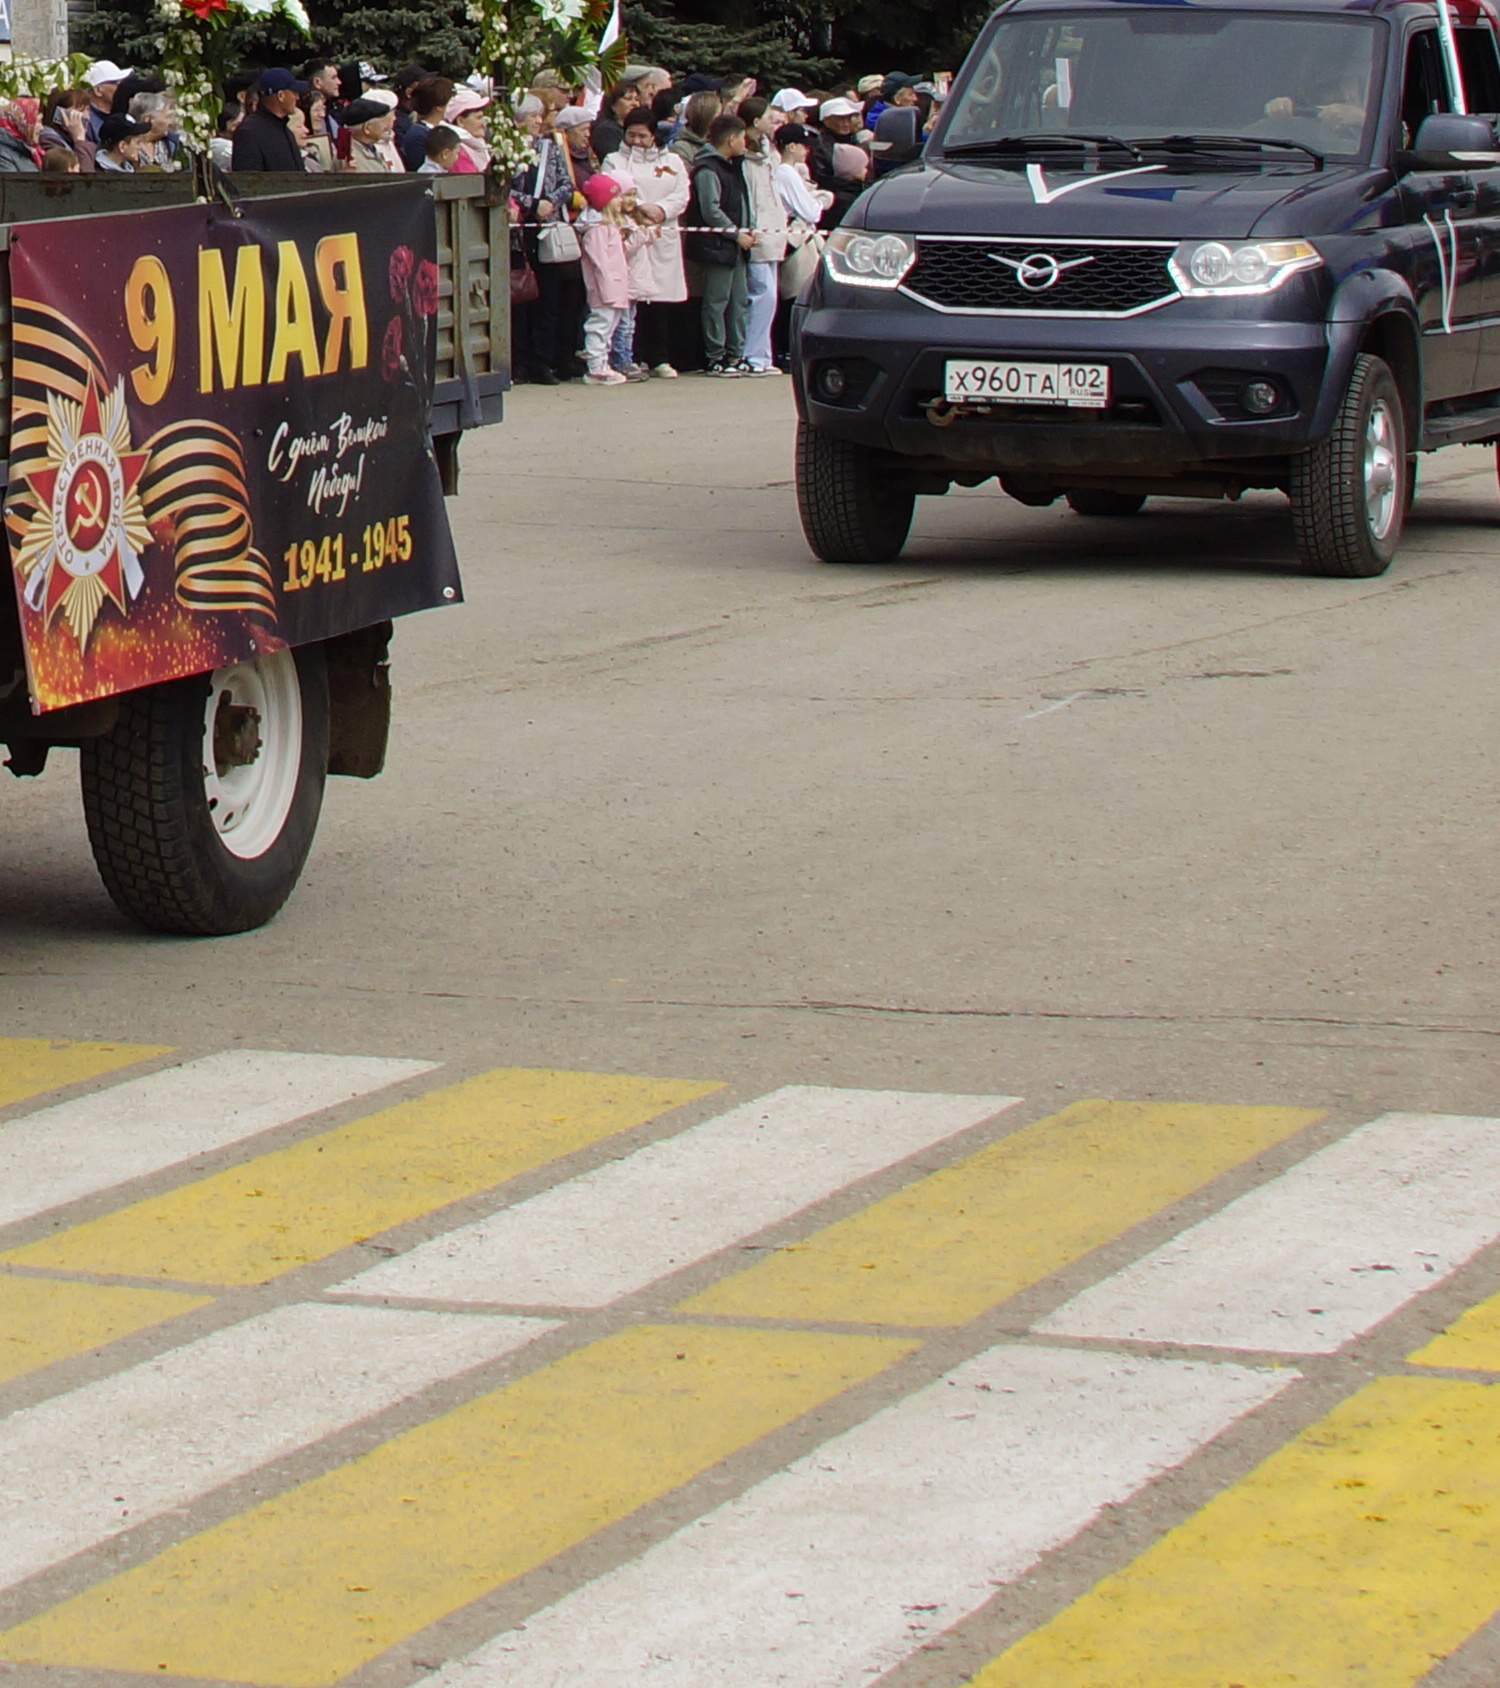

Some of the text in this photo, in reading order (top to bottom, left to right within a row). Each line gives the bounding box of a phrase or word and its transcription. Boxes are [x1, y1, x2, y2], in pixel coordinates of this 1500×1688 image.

[125, 231, 368, 406] 9 МАЯ
[1062, 367, 1100, 388] 102
[329, 412, 388, 458] Великой
[54, 438, 123, 564] ОТЕЧЕСТВЕННАЯ ВОЙНА
[306, 452, 365, 518] Победы!
